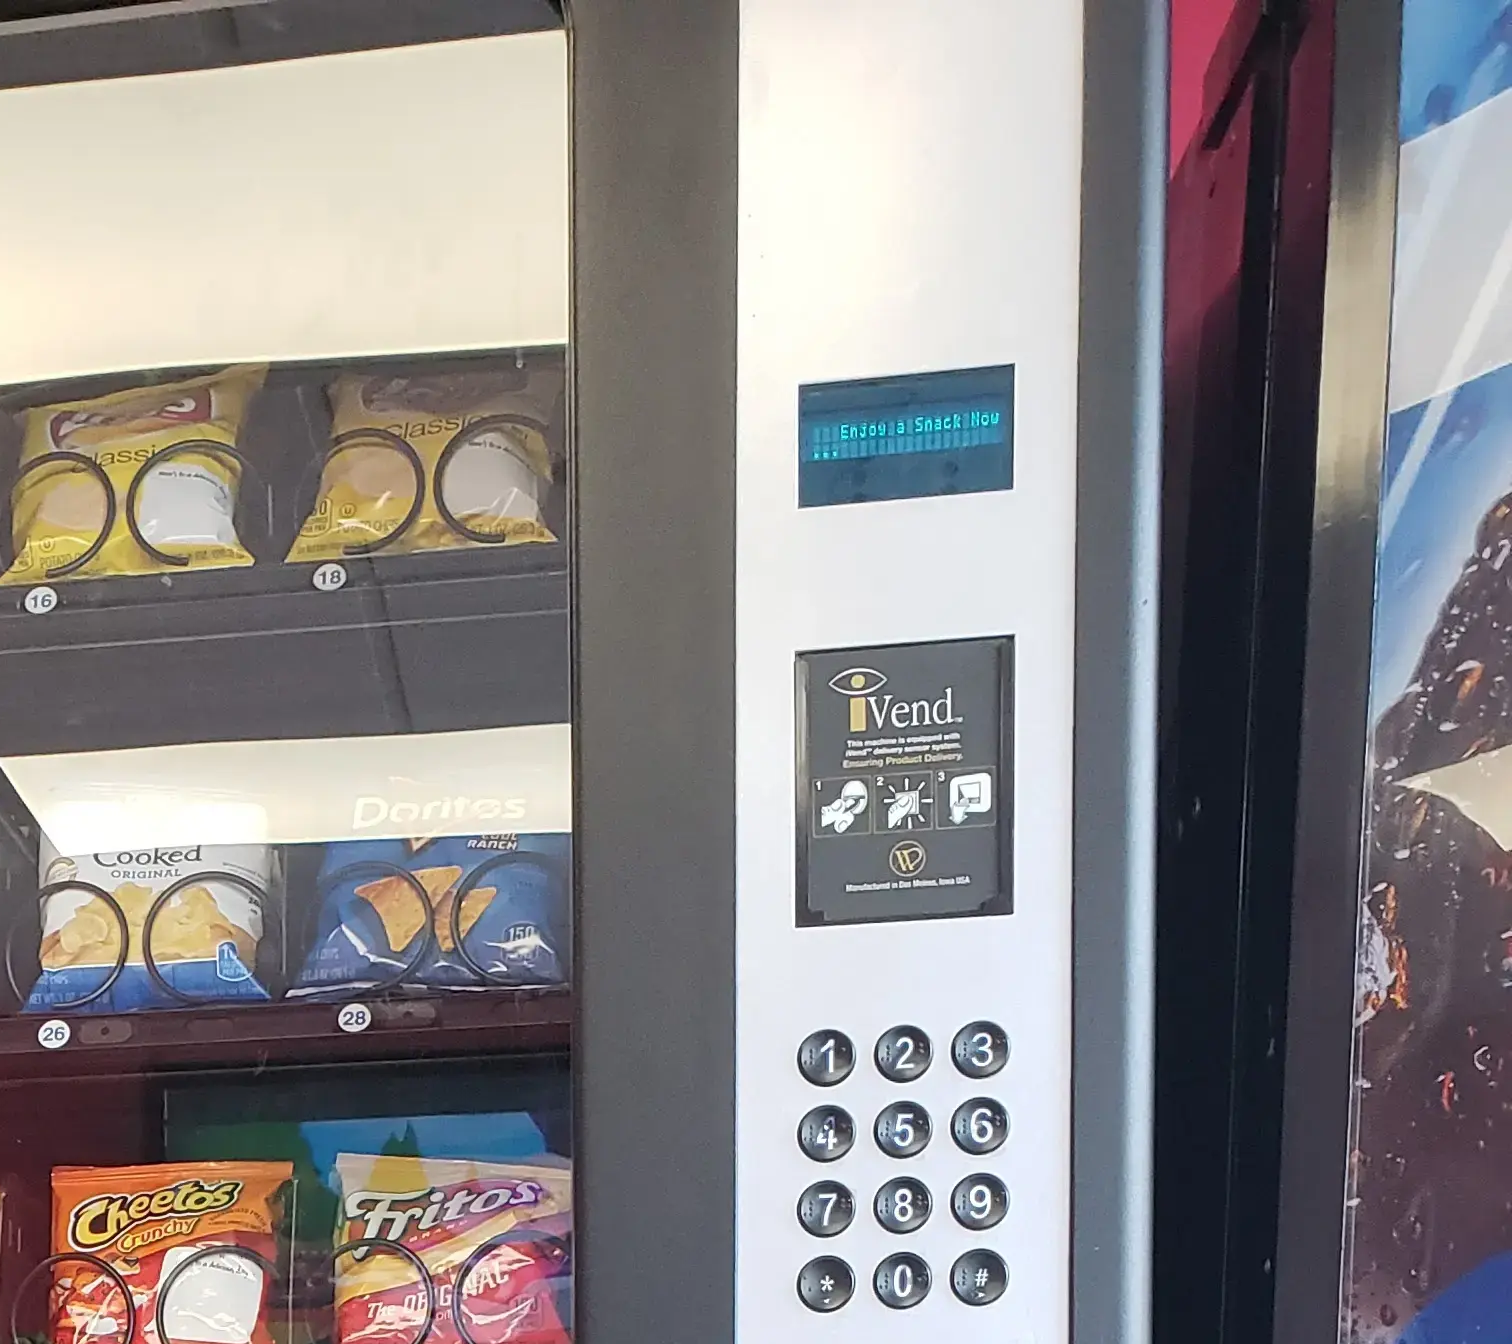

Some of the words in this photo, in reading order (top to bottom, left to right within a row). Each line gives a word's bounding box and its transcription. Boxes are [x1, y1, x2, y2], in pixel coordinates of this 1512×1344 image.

[840, 421, 886, 440] Enjoy
[897, 420, 905, 434] a
[915, 414, 961, 433] Snack
[970, 411, 1000, 427] Now
[317, 569, 343, 586] 18
[30, 593, 53, 609] 16
[849, 674, 954, 732] iVend
[864, 737, 897, 747] machine
[842, 758, 884, 769] Ensuring
[885, 754, 924, 766] Product
[924, 751, 964, 764] Delivery.
[937, 771, 946, 782] 3
[815, 781, 823, 791] 1
[876, 776, 885, 787] 2
[352, 796, 528, 830] Doritos
[466, 839, 519, 851] RANCH
[110, 867, 182, 880] ORIGINAL
[508, 925, 536, 940] 150
[42, 1026, 67, 1042] 26
[342, 1010, 367, 1026] 28
[820, 1038, 836, 1074] 1
[895, 1036, 916, 1070] 2
[970, 1032, 994, 1068] 3
[816, 1115, 838, 1151] 4
[893, 1113, 915, 1148] 5
[969, 1107, 994, 1144] 6
[74, 1180, 243, 1248] Cheetos
[817, 1192, 838, 1227] 7
[893, 1187, 914, 1223] 8
[969, 1184, 992, 1220] 9
[117, 1217, 200, 1252] Crunchy
[344, 1181, 543, 1261] Fritos
[892, 1263, 914, 1298] 0
